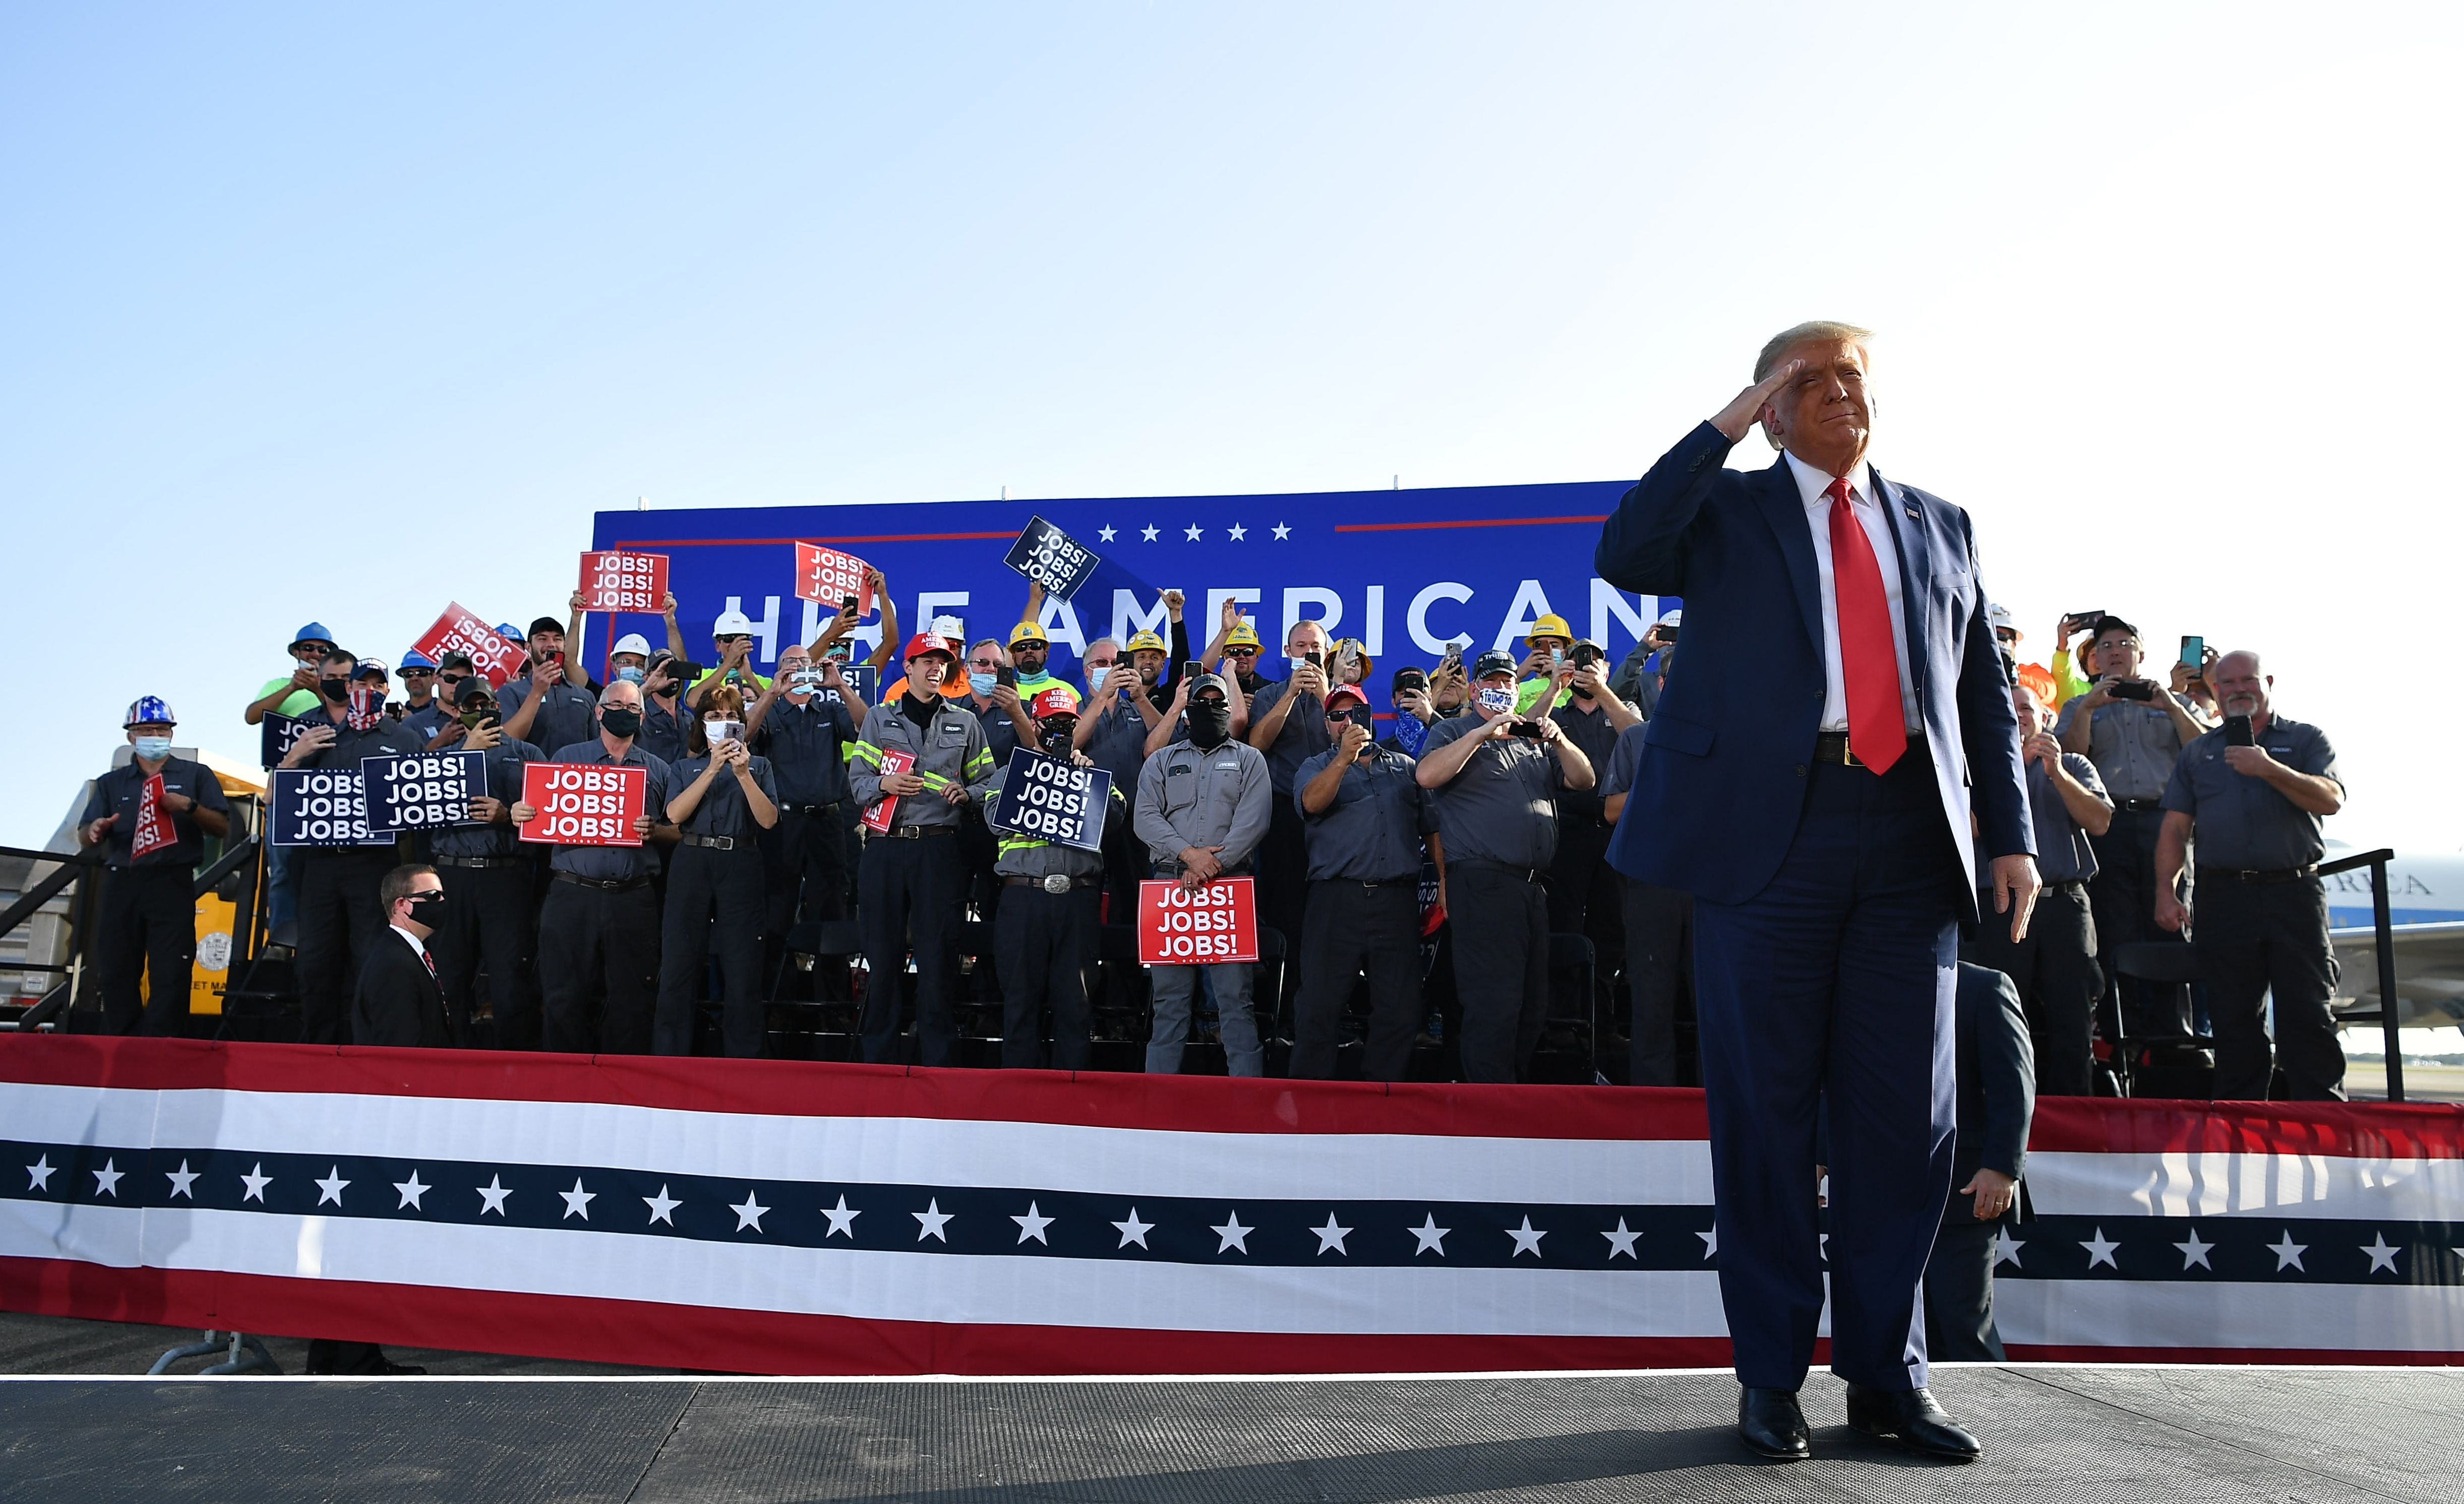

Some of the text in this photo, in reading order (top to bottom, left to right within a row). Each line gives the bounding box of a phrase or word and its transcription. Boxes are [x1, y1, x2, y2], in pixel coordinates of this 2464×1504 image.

[1038, 530, 1088, 567] JOBS!
[594, 556, 654, 573] JOBS!
[810, 550, 863, 574] JOBS!
[1028, 544, 1078, 581] JOBS!
[593, 573, 653, 591] JOBS!
[810, 566, 862, 592] JOBS!
[1018, 558, 1067, 594] JOBS!
[592, 591, 652, 608] JOBS!
[809, 583, 860, 604] JOB
[1038, 577, 1659, 658] AMERICAN
[454, 615, 512, 659] JOBS!
[1484, 693, 1504, 705] TRUMP
[384, 757, 466, 781] JOBS!
[545, 770, 626, 792] JOBS!
[1024, 758, 1093, 793] JOBS!
[294, 775, 363, 794] JOBS
[386, 779, 467, 803] JOBS!
[294, 797, 366, 817] JOBS
[543, 793, 625, 815] JOBS!
[1016, 782, 1089, 817] JOBS!
[388, 802, 469, 826] JOBS!
[1009, 806, 1084, 840] JOBS!
[542, 816, 624, 838] JOBS!
[1157, 885, 1235, 908] JOBS!
[1157, 909, 1236, 933] JOBS!
[1158, 934, 1237, 957] JOBS!
